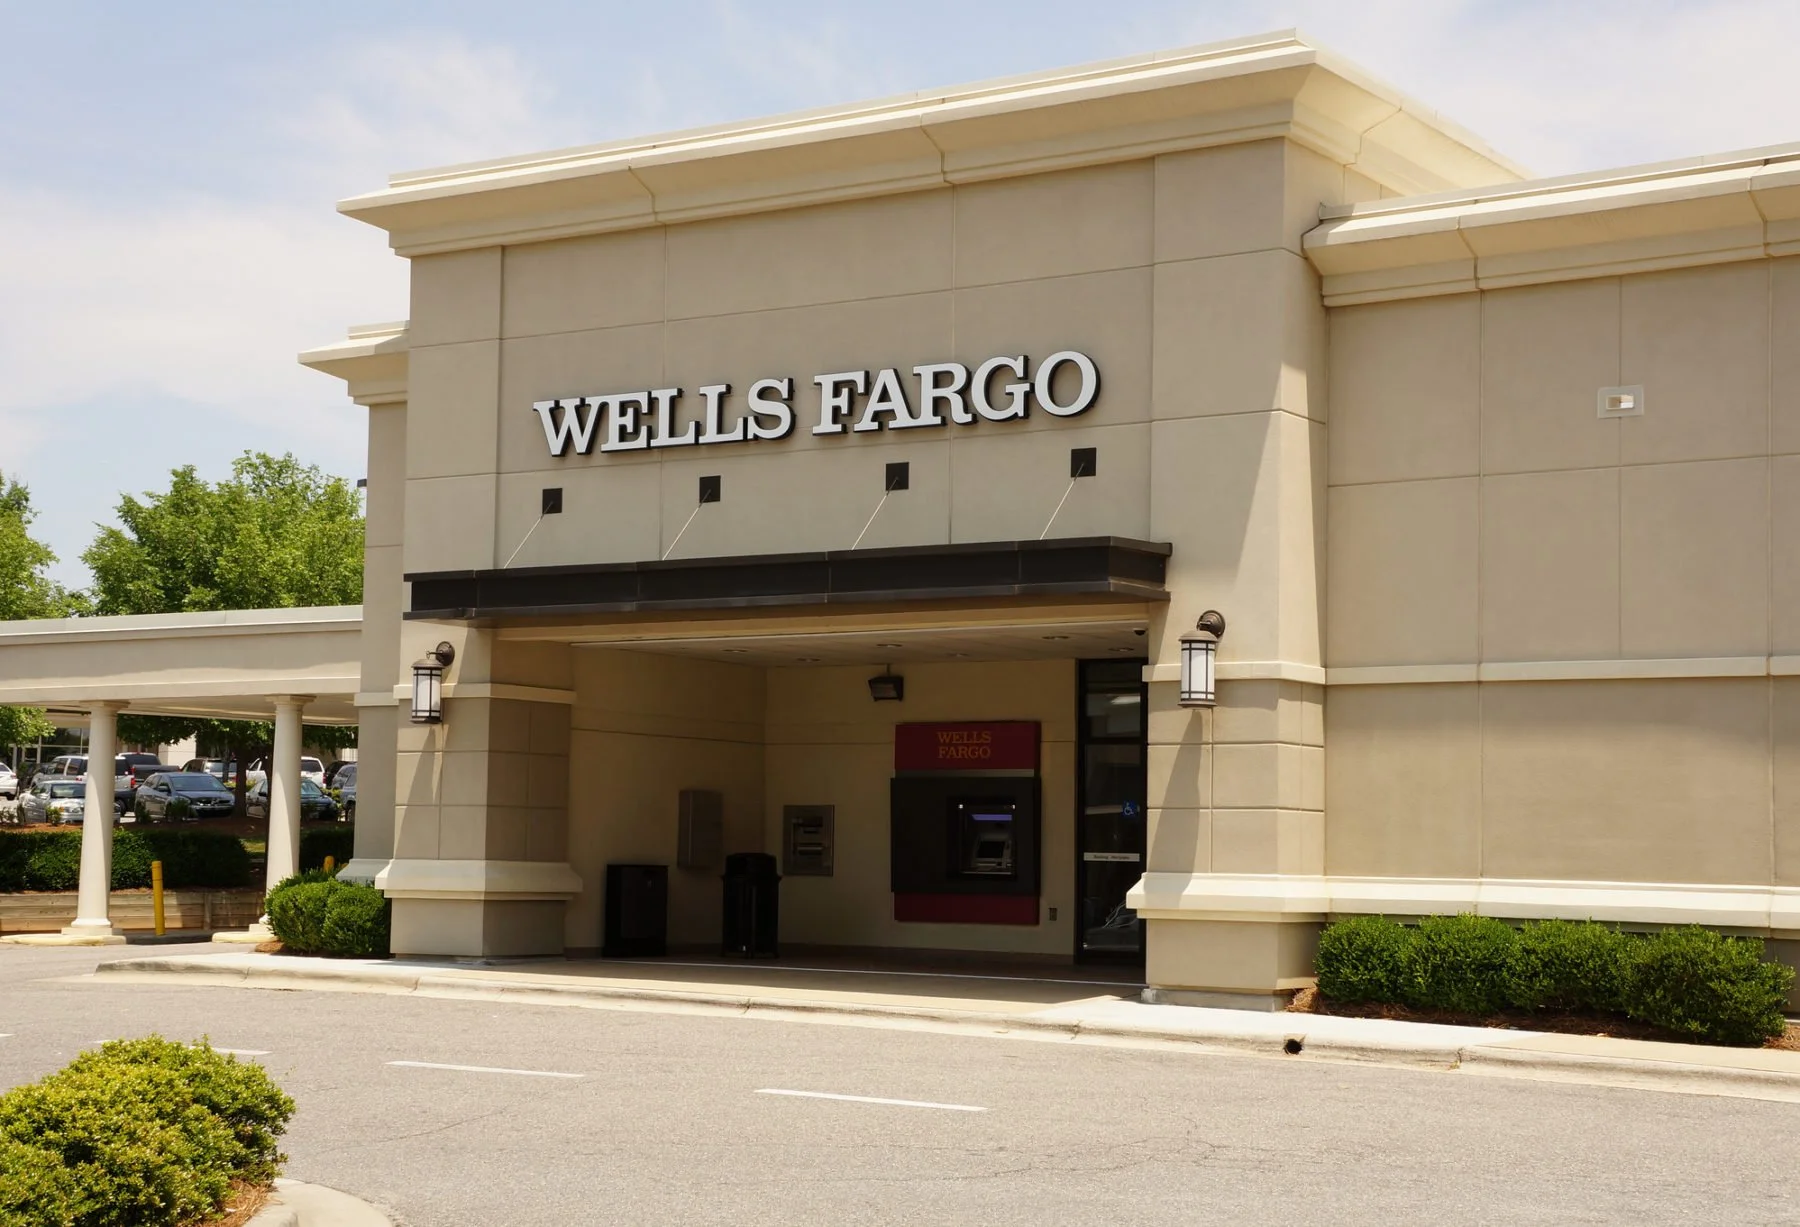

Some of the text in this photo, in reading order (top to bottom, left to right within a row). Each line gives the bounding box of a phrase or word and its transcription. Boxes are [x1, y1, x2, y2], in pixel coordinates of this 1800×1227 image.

[532, 350, 1100, 457] WELLS FARGO
[936, 730, 992, 744] WELLS
[937, 745, 992, 759] FARGO
